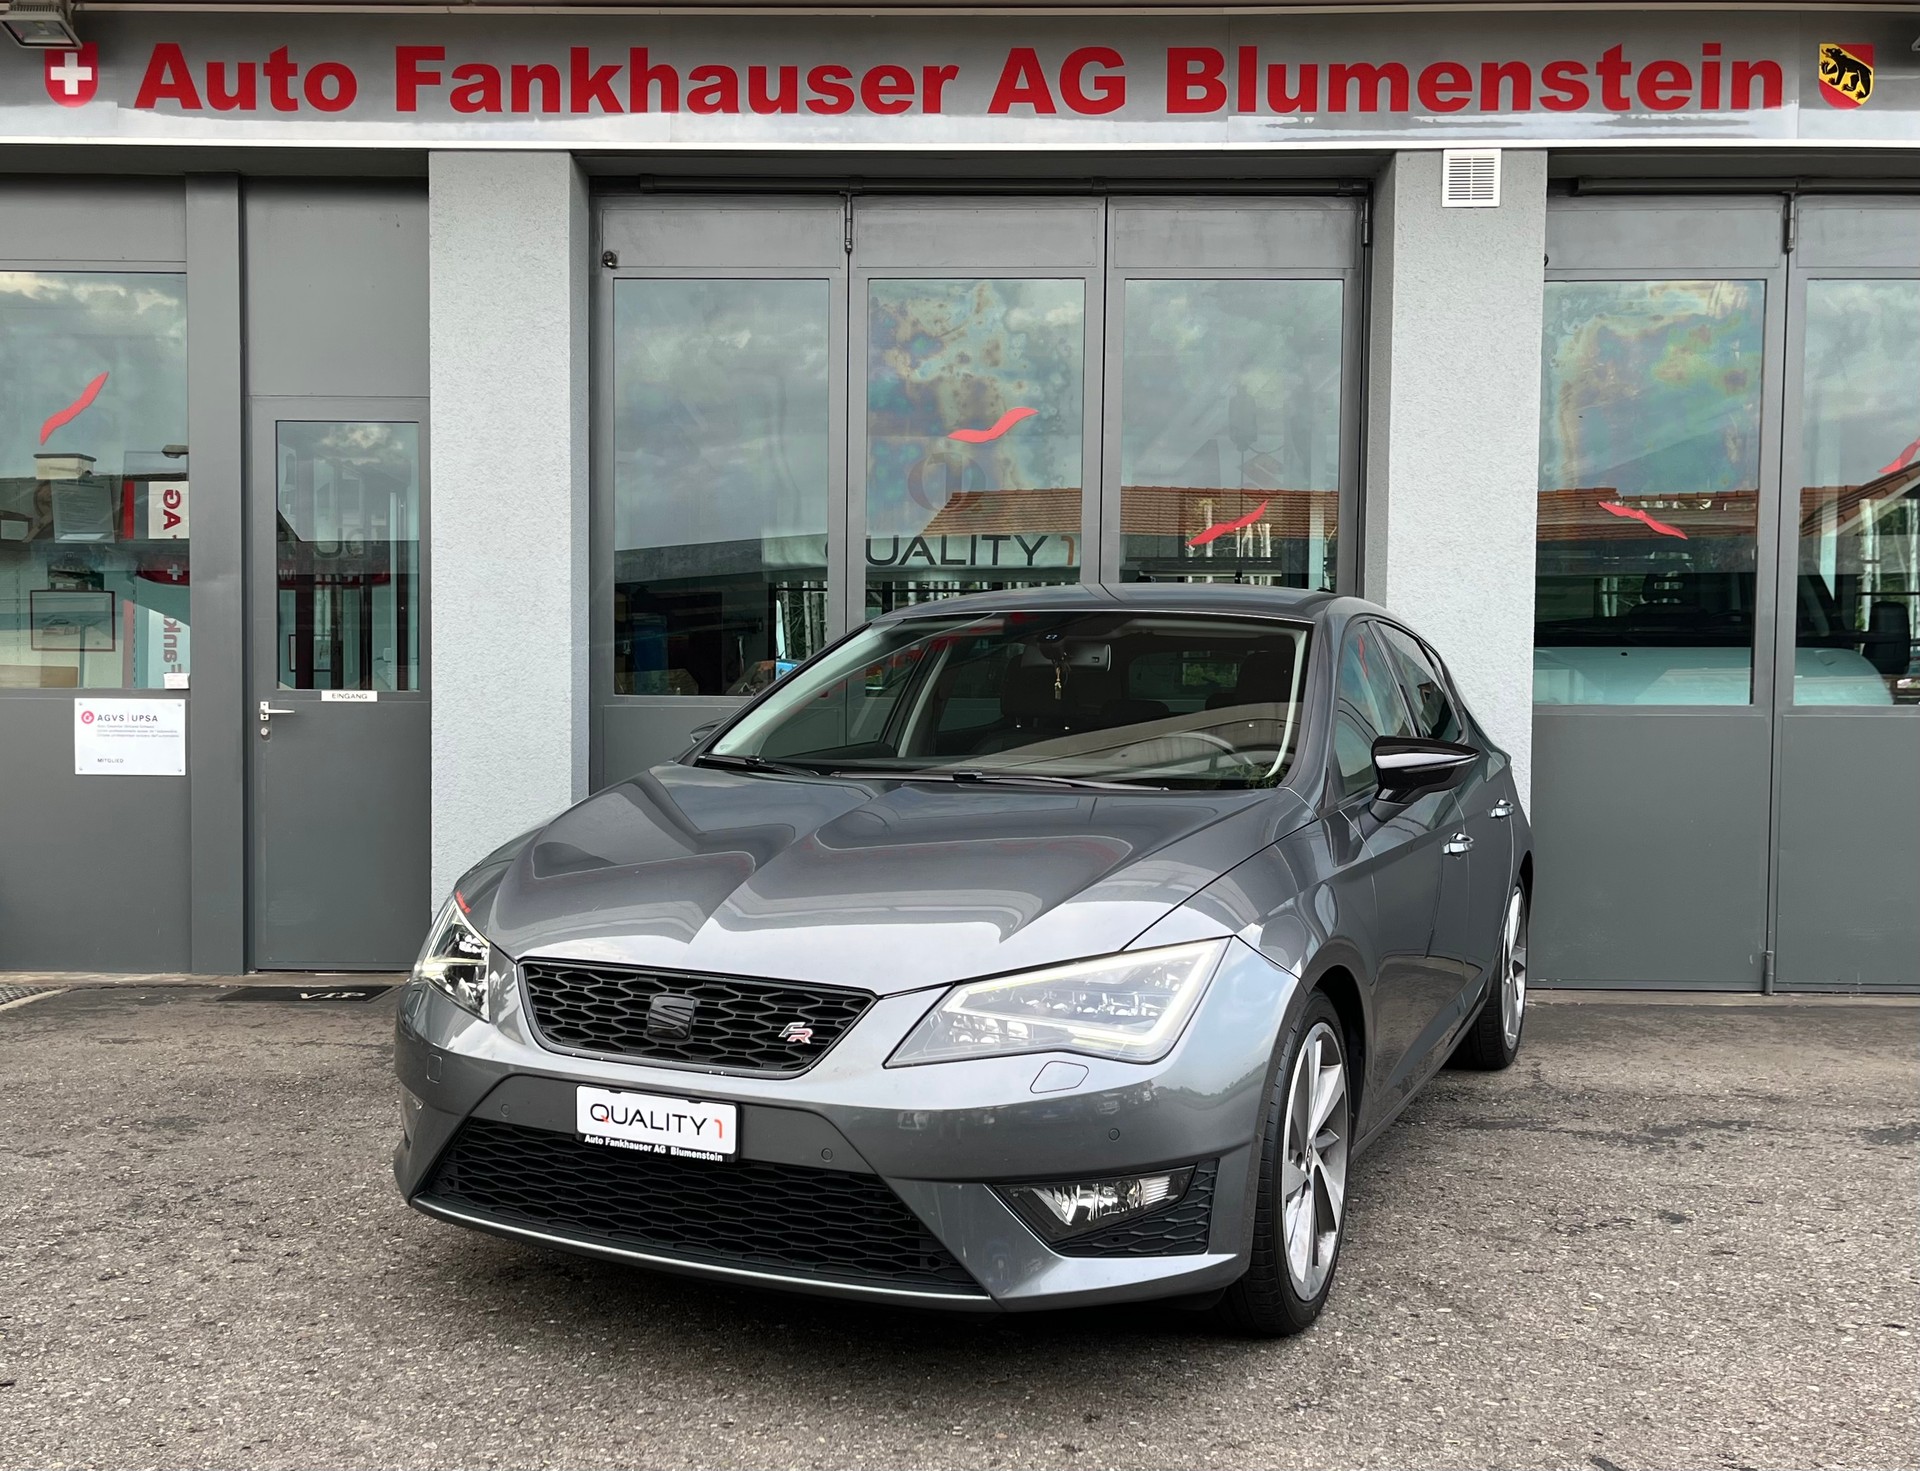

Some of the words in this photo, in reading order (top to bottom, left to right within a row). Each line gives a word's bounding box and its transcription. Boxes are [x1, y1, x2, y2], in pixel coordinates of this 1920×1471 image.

[135, 43, 357, 112] Auto
[395, 46, 960, 115] Fankhauser
[988, 46, 1126, 115] AG
[1166, 42, 1783, 114] Blumenstein
[825, 533, 1049, 567] UALITY
[331, 692, 368, 700] EINGANG
[97, 714, 125, 722] AGVS
[131, 714, 159, 722] UPSA
[590, 1102, 708, 1136] QUALITY
[714, 1118, 723, 1139] 1
[584, 1134, 604, 1146] Auto
[605, 1137, 653, 1153] Fankhauser
[653, 1144, 667, 1154] AG
[670, 1146, 724, 1162] Blumenstein
